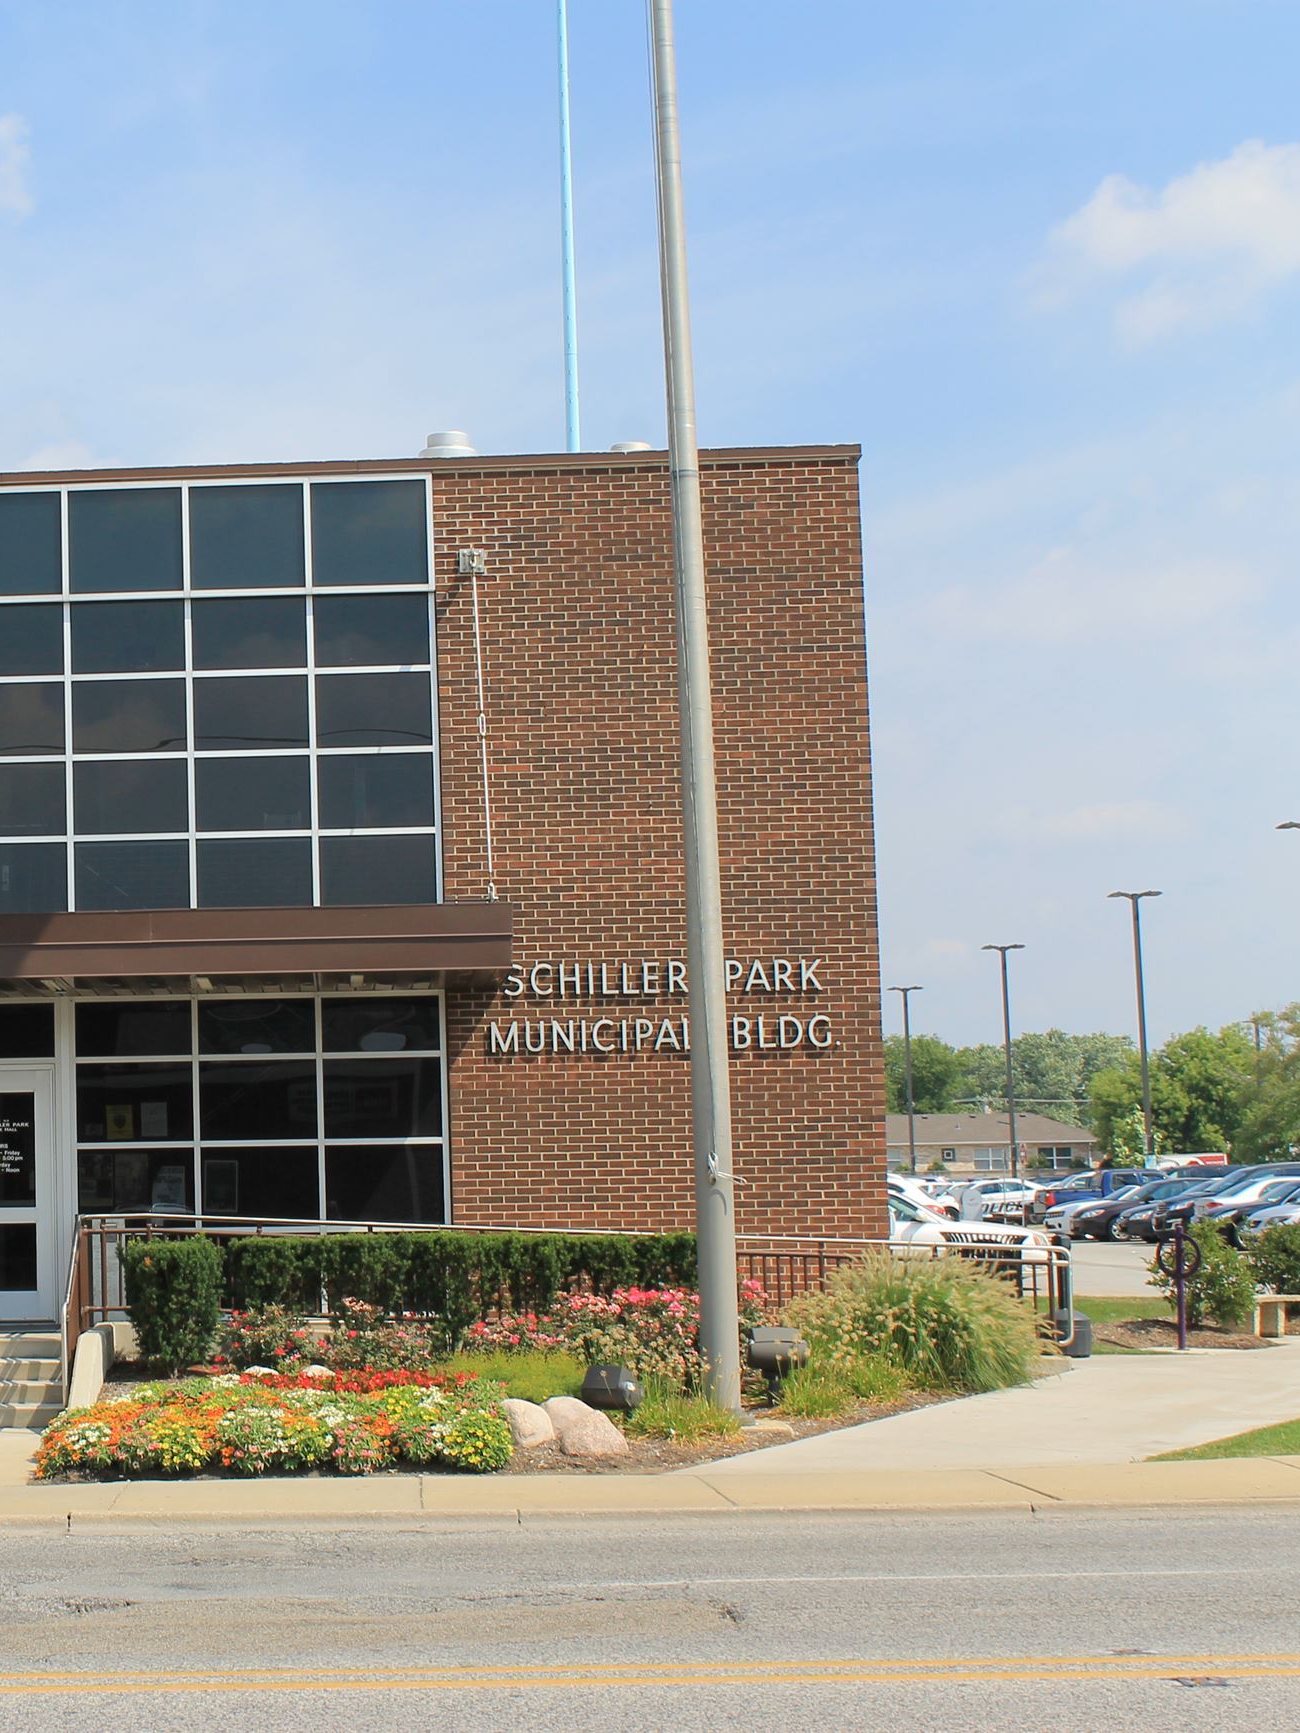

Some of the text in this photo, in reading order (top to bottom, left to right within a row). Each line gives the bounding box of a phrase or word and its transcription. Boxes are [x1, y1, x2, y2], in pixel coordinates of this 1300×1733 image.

[504, 958, 822, 997] SCHILLER PARK
[490, 1014, 842, 1053] MUNICIPAL BLDG.
[981, 1200, 1023, 1213] OLICE
